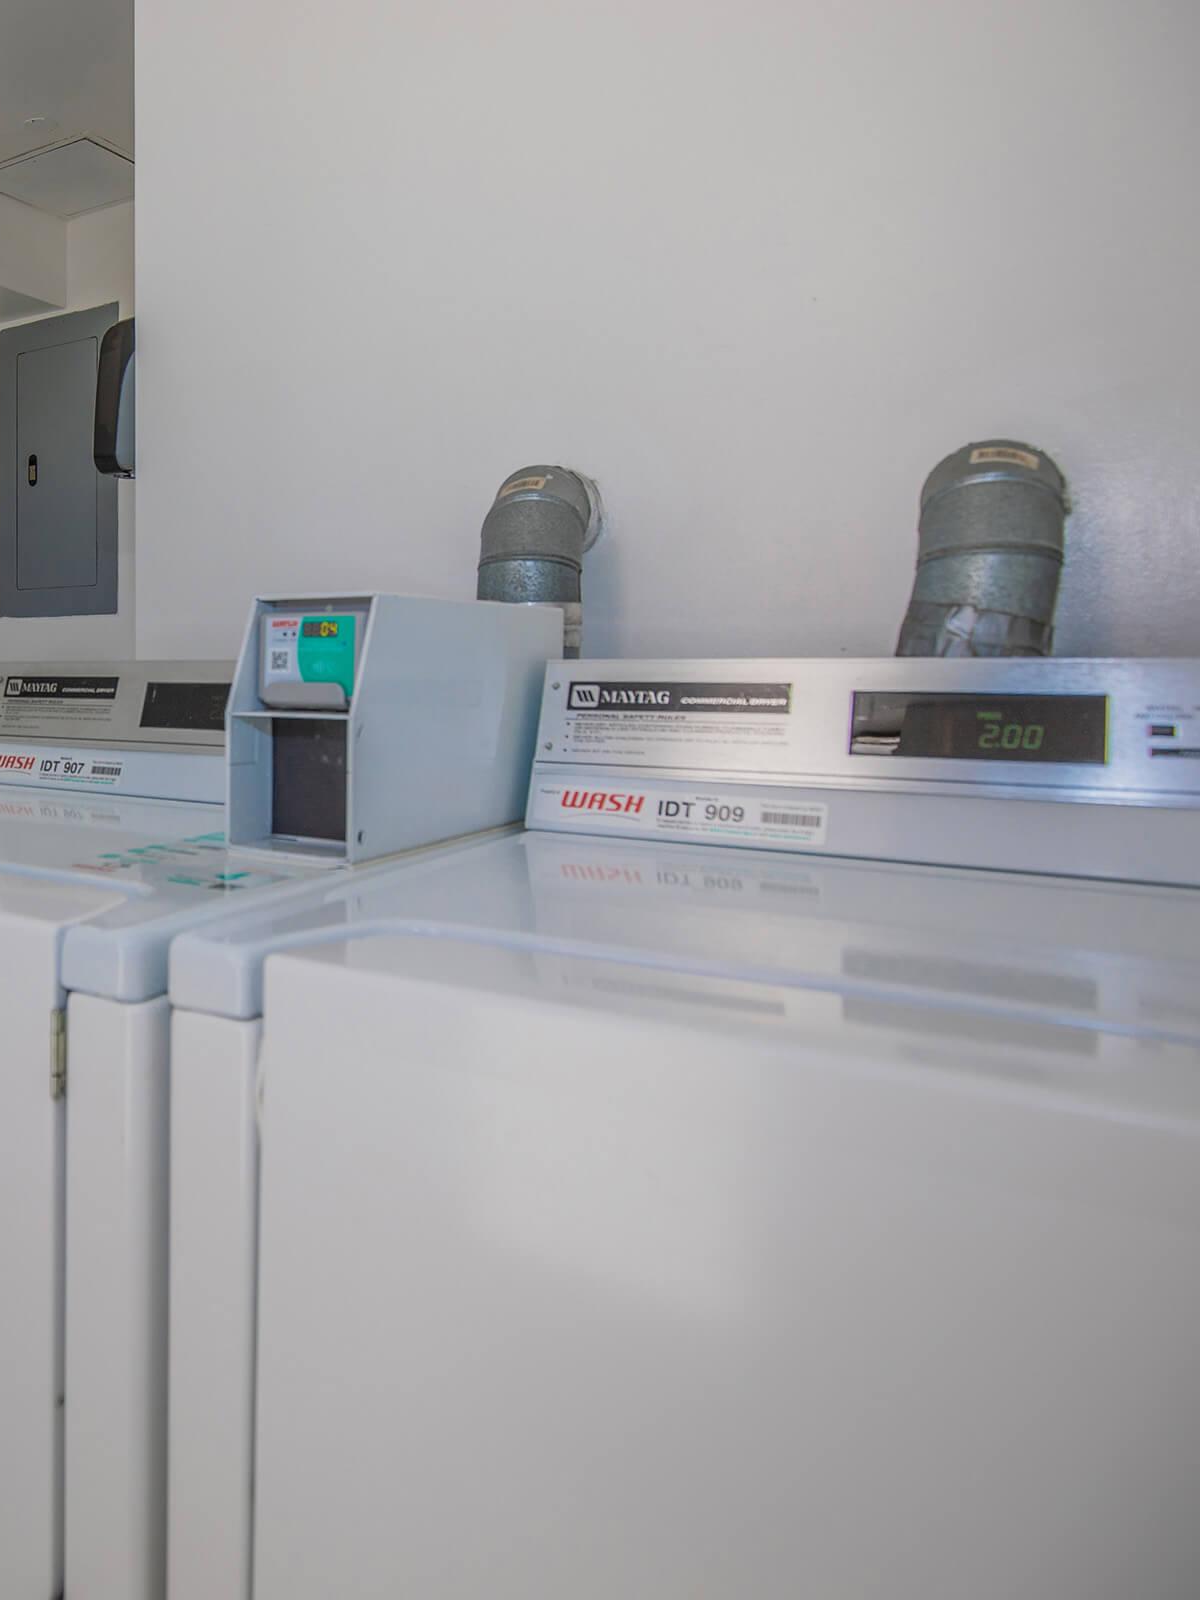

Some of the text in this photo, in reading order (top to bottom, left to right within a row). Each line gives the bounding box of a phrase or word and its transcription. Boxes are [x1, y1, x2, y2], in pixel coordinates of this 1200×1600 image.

[21, 682, 58, 693] MAYTAG
[600, 690, 787, 706] MAYTAG COMMERCIAL DRYER
[977, 724, 1044, 749] 2.00
[40, 760, 61, 772] IDT
[63, 761, 85, 774] 907
[561, 790, 645, 814] WASH
[658, 800, 696, 818] IDT
[704, 804, 745, 823] 909
